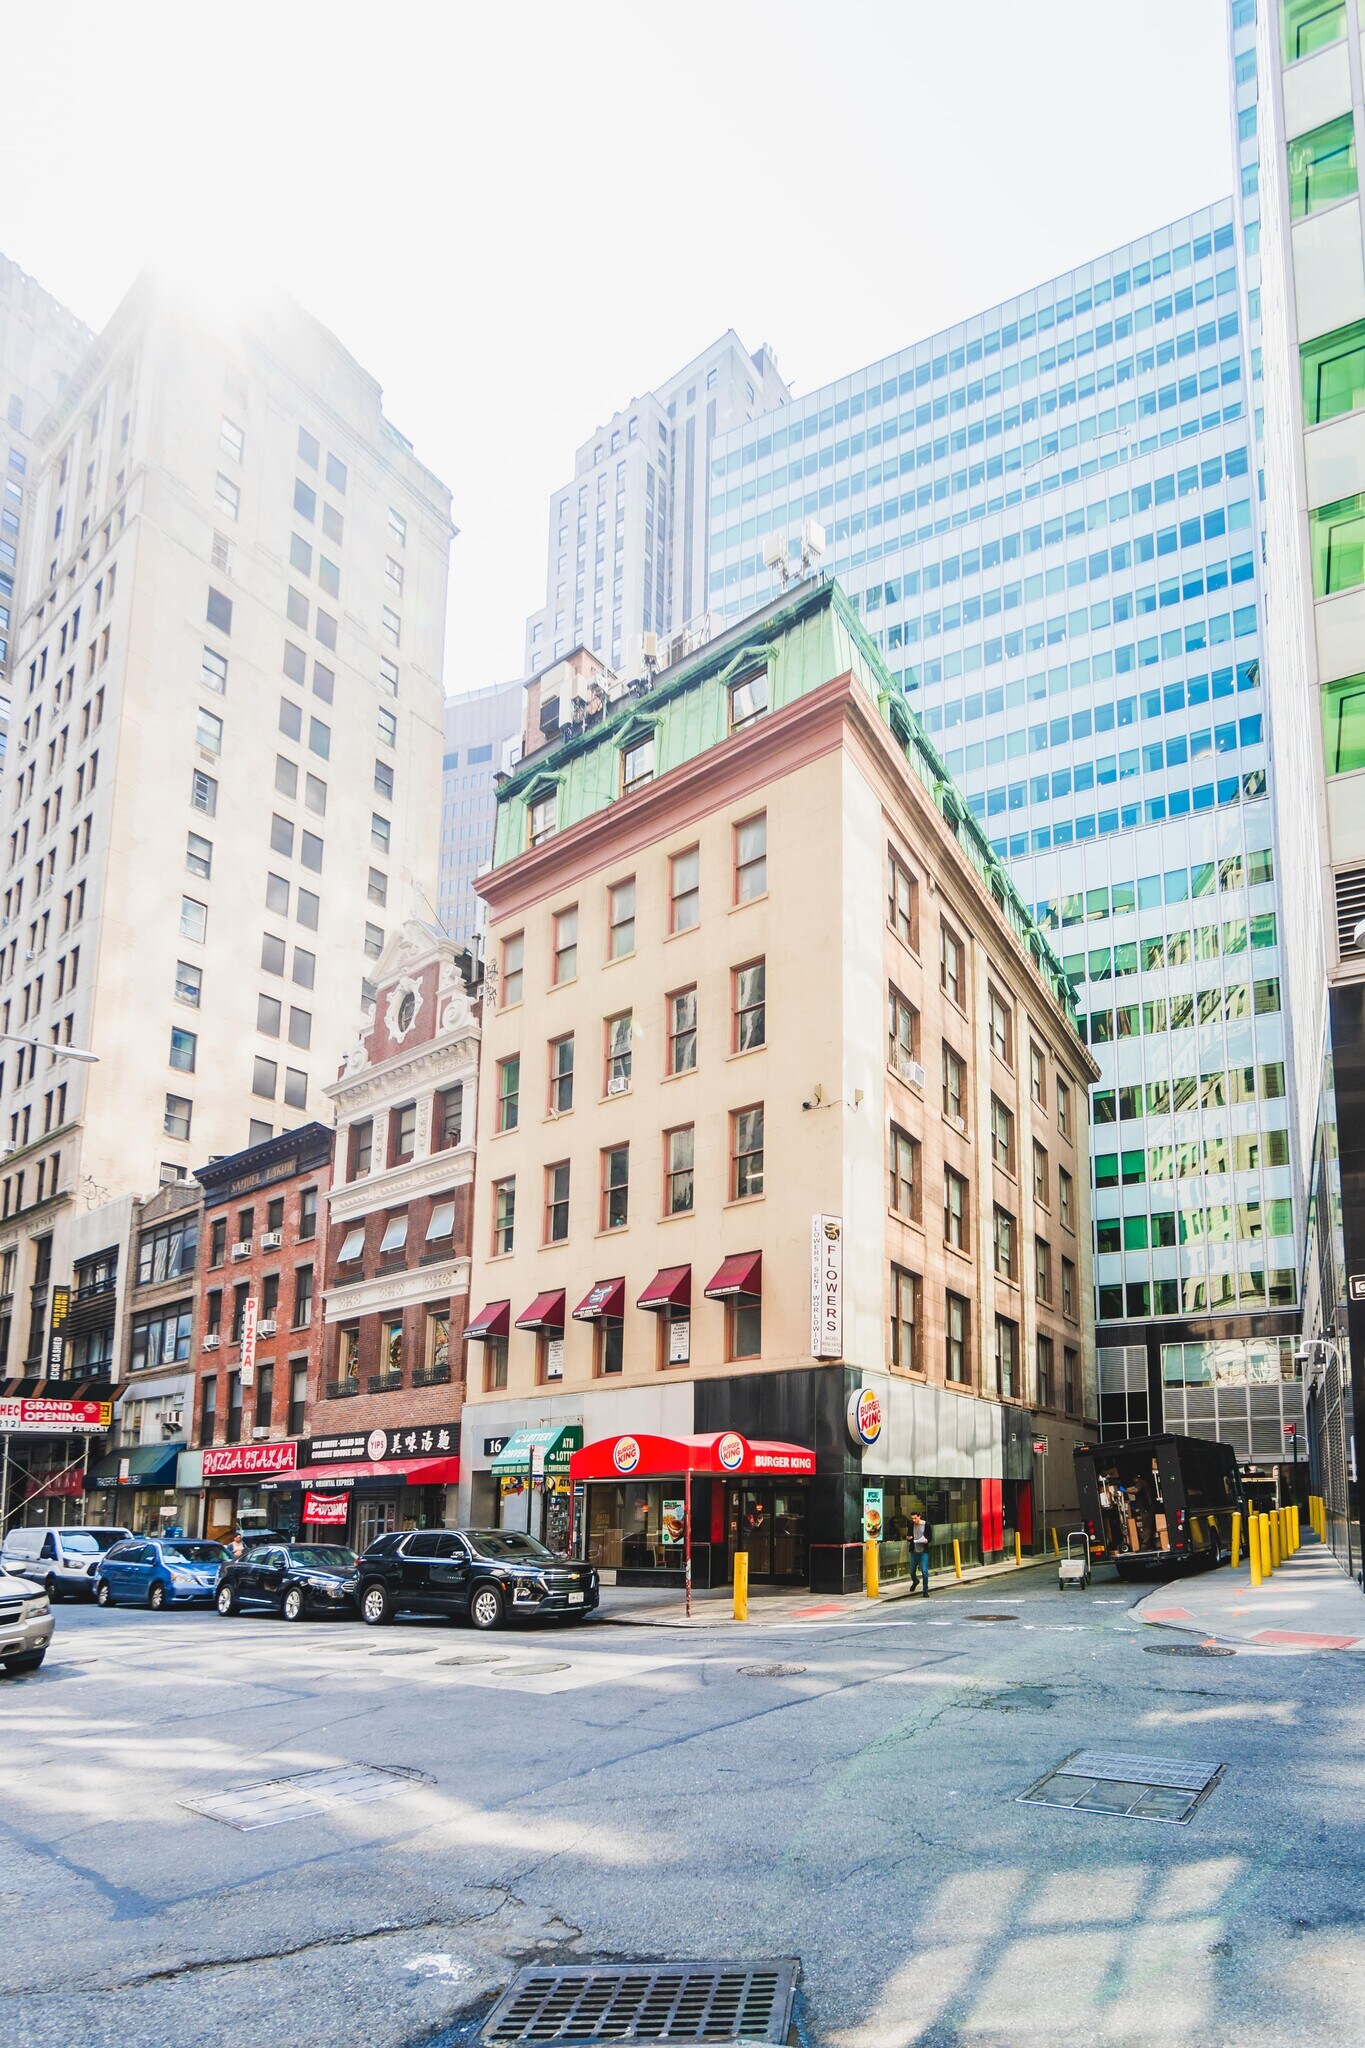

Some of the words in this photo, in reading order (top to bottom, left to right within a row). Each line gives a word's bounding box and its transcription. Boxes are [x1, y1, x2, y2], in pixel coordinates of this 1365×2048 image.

[231, 1172, 261, 1193] SAMUEL
[825, 1245, 838, 1331] FLOWERS
[52, 1294, 63, 1328] WESTERN
[59, 1294, 69, 1318] UNION
[243, 1300, 255, 1366] PIZZA
[51, 1336, 63, 1362] CASHED
[50, 1363, 61, 1380] ECKS
[24, 1401, 73, 1411] GRAND
[860, 1400, 880, 1417] BURGER
[24, 1411, 85, 1421] OPENING
[861, 1410, 881, 1431] KING
[524, 1431, 556, 1442] LOTTERY
[562, 1437, 574, 1448] ATM
[351, 1447, 365, 1456] SOUP
[370, 1440, 384, 1449] YIPS
[489, 1439, 502, 1453] 16
[617, 1443, 636, 1456] BURGER
[722, 1441, 740, 1453] BURGER
[617, 1449, 637, 1464] KING
[723, 1447, 741, 1461] KING
[204, 1451, 243, 1474] PIZZA
[755, 1455, 789, 1467] BURGER
[790, 1456, 811, 1468] KING
[301, 1480, 313, 1489] YIPS
[315, 1479, 335, 1488] ORIENTAL
[336, 1478, 355, 1487] EXPRESS
